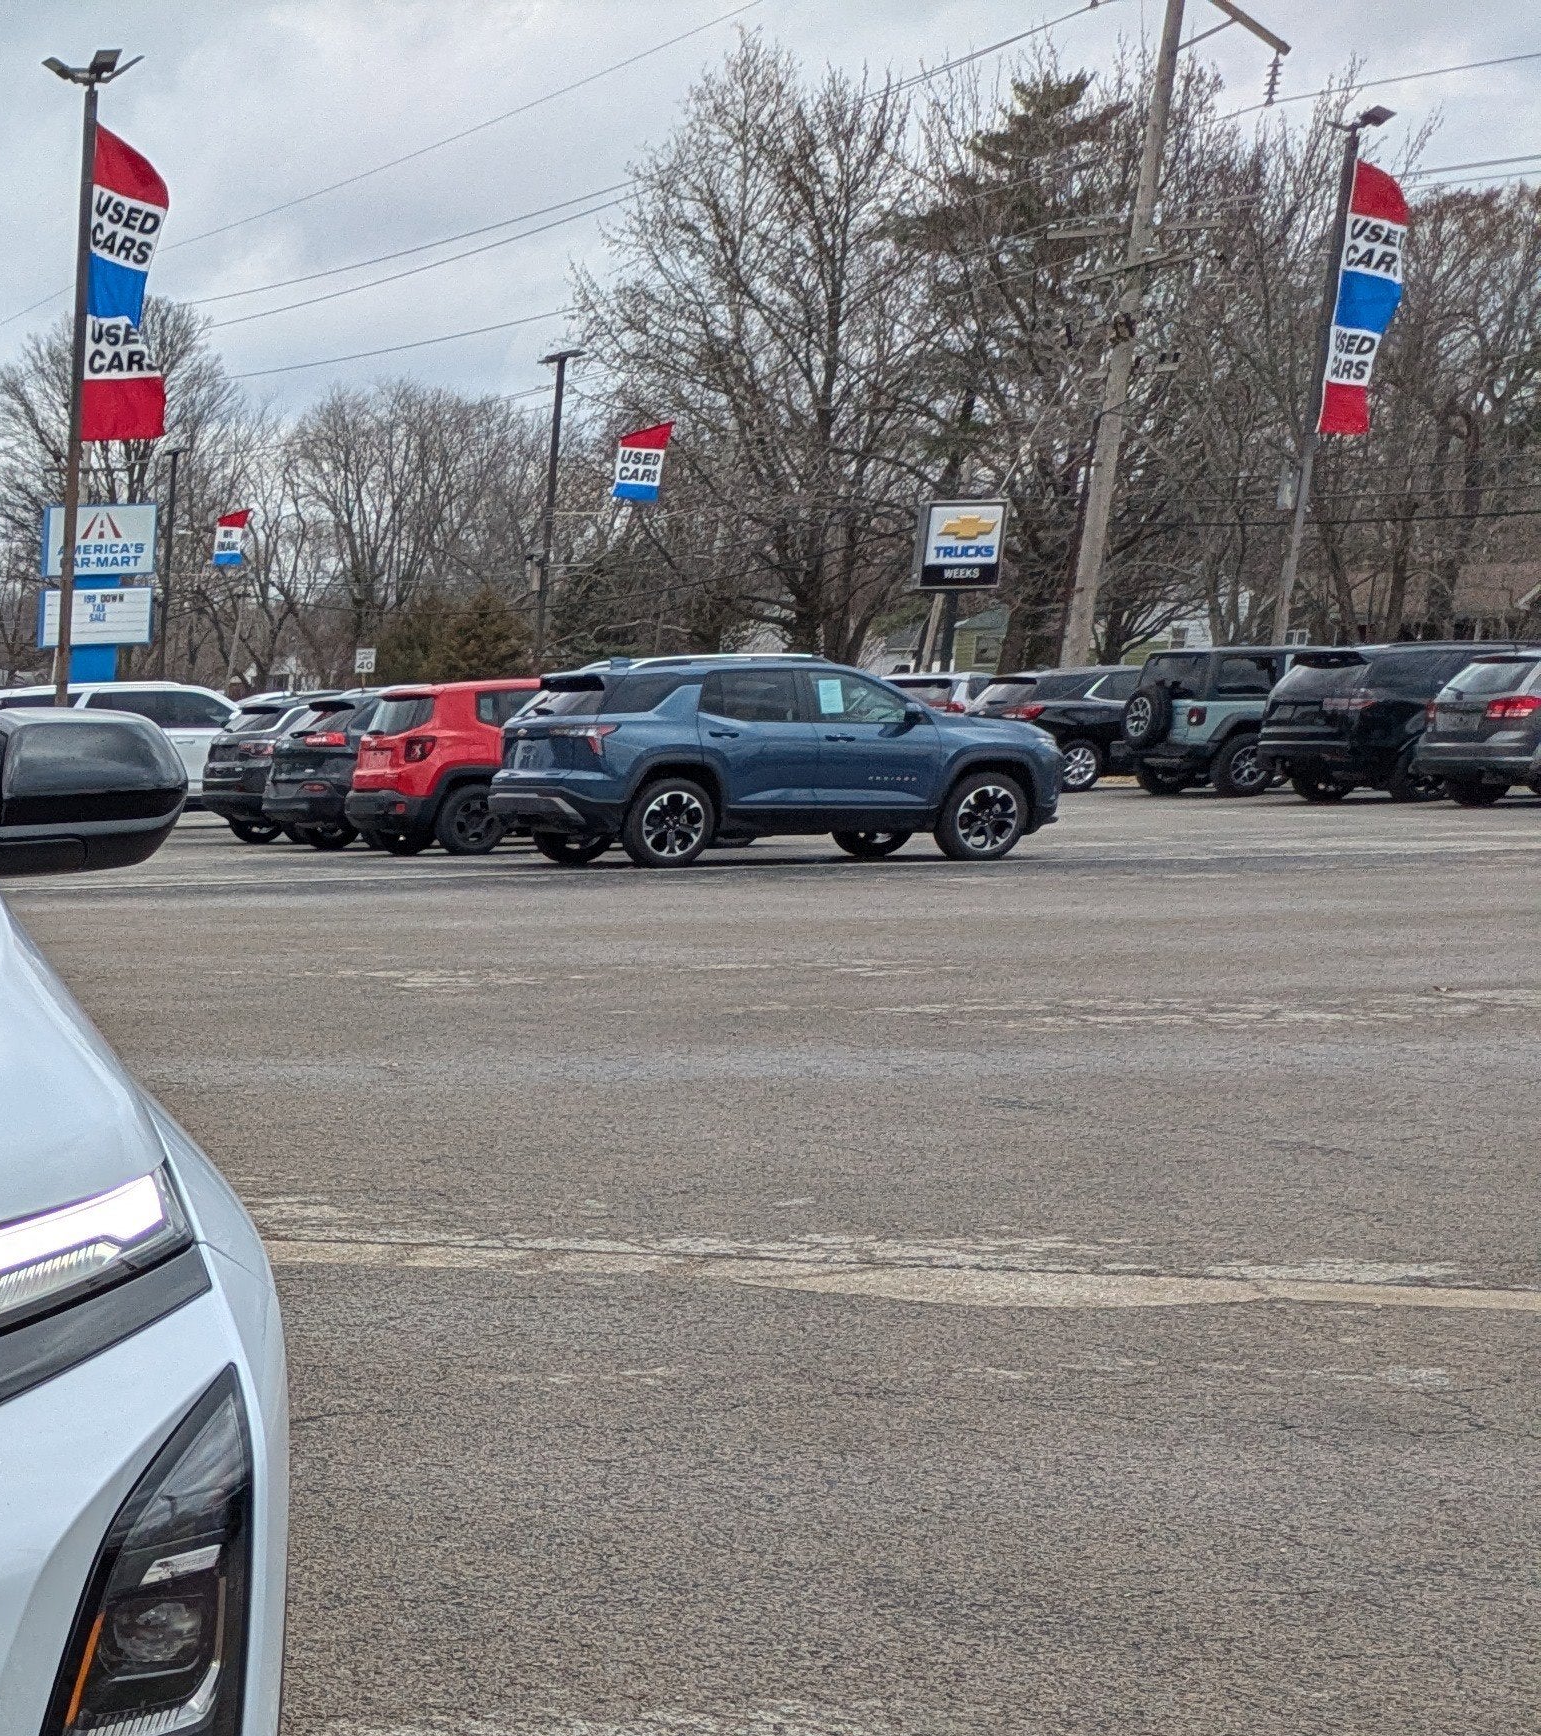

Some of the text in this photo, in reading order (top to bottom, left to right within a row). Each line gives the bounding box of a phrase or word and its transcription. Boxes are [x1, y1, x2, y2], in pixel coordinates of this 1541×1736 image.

[96, 191, 161, 235] USED
[92, 222, 153, 265] CARS
[1345, 243, 1398, 277] CAR
[92, 320, 139, 346] USE
[1335, 328, 1376, 355] USED
[620, 450, 661, 466] USED
[619, 466, 658, 483] CARS
[934, 545, 996, 559] TRUCKS
[60, 555, 142, 569] AR-MART
[943, 567, 981, 579] WEEKS
[357, 661, 373, 670] 40
